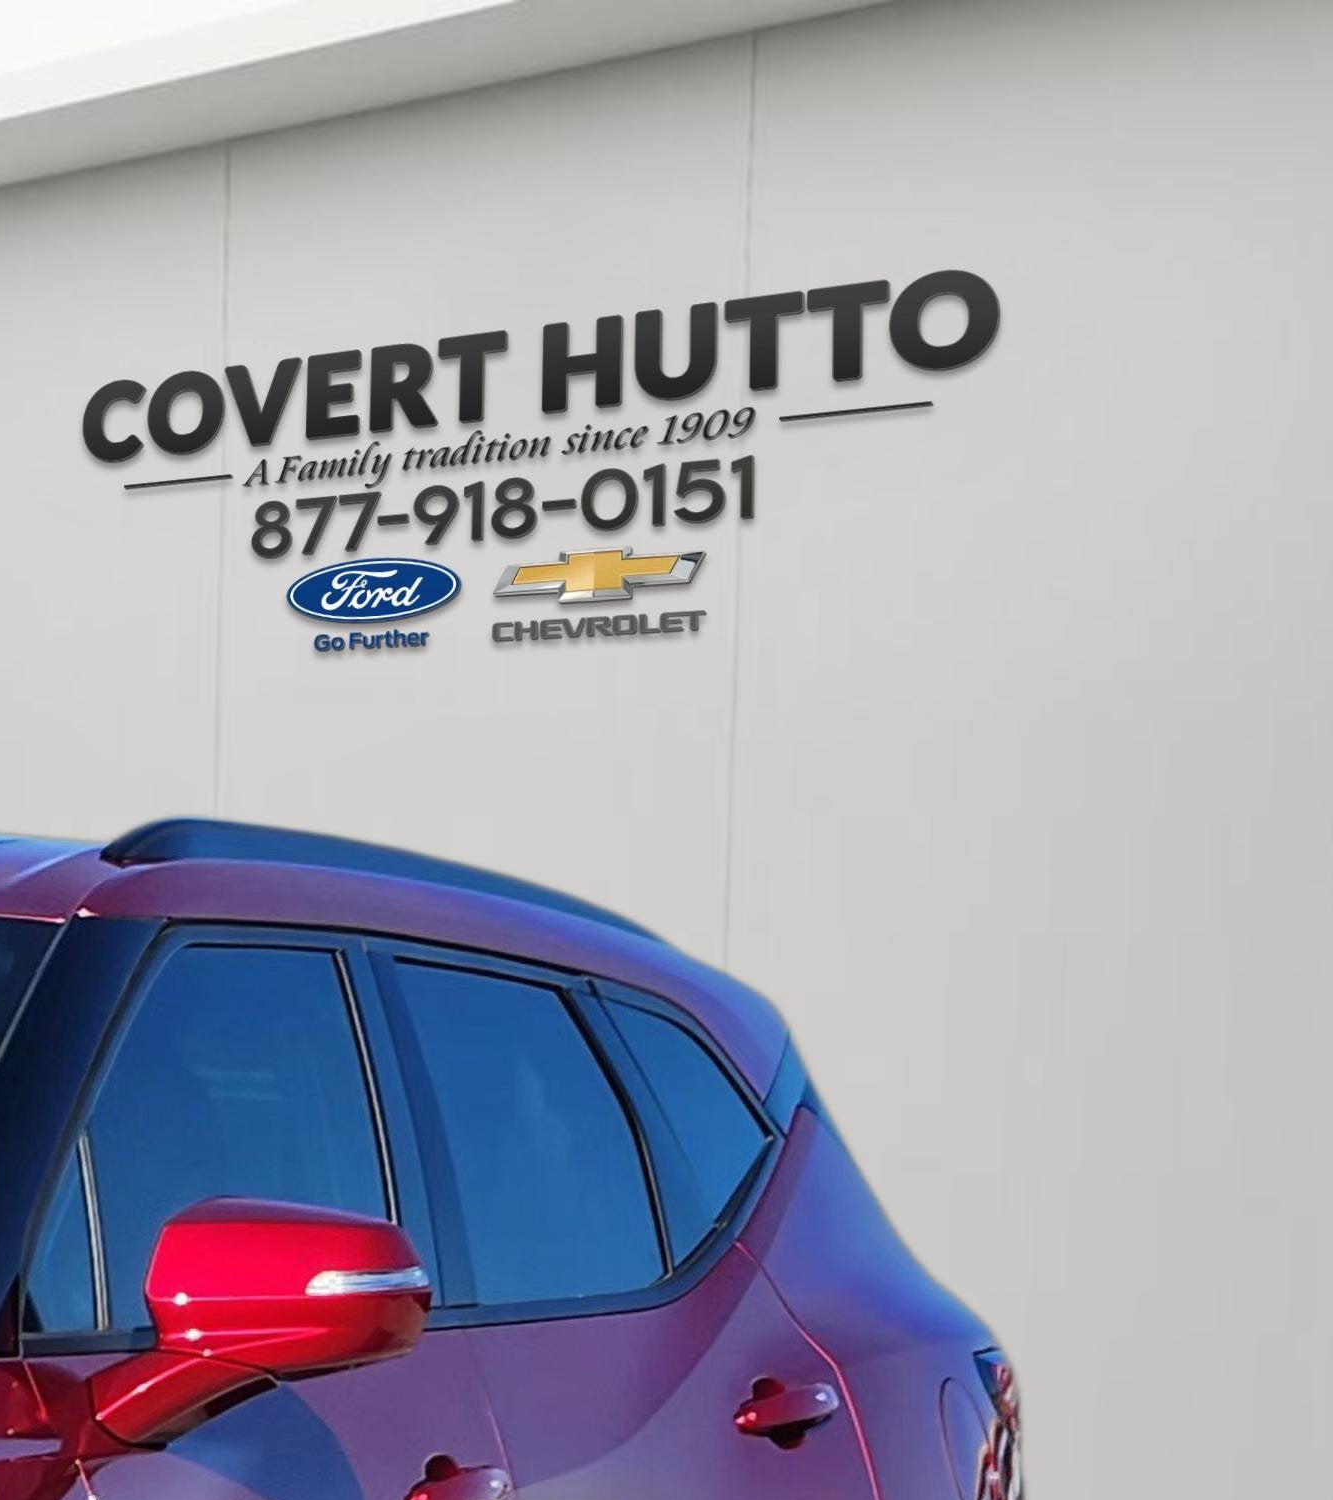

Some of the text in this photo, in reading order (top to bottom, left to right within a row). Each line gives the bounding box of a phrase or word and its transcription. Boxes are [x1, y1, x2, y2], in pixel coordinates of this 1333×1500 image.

[82, 269, 1001, 464] COVERT HUTTO
[242, 406, 757, 488] A Family tradition since 1909
[250, 454, 756, 560] 877-918-0151
[320, 569, 425, 612] Ford
[313, 628, 430, 653] Go Further
[491, 609, 707, 644] CHEVROLET
